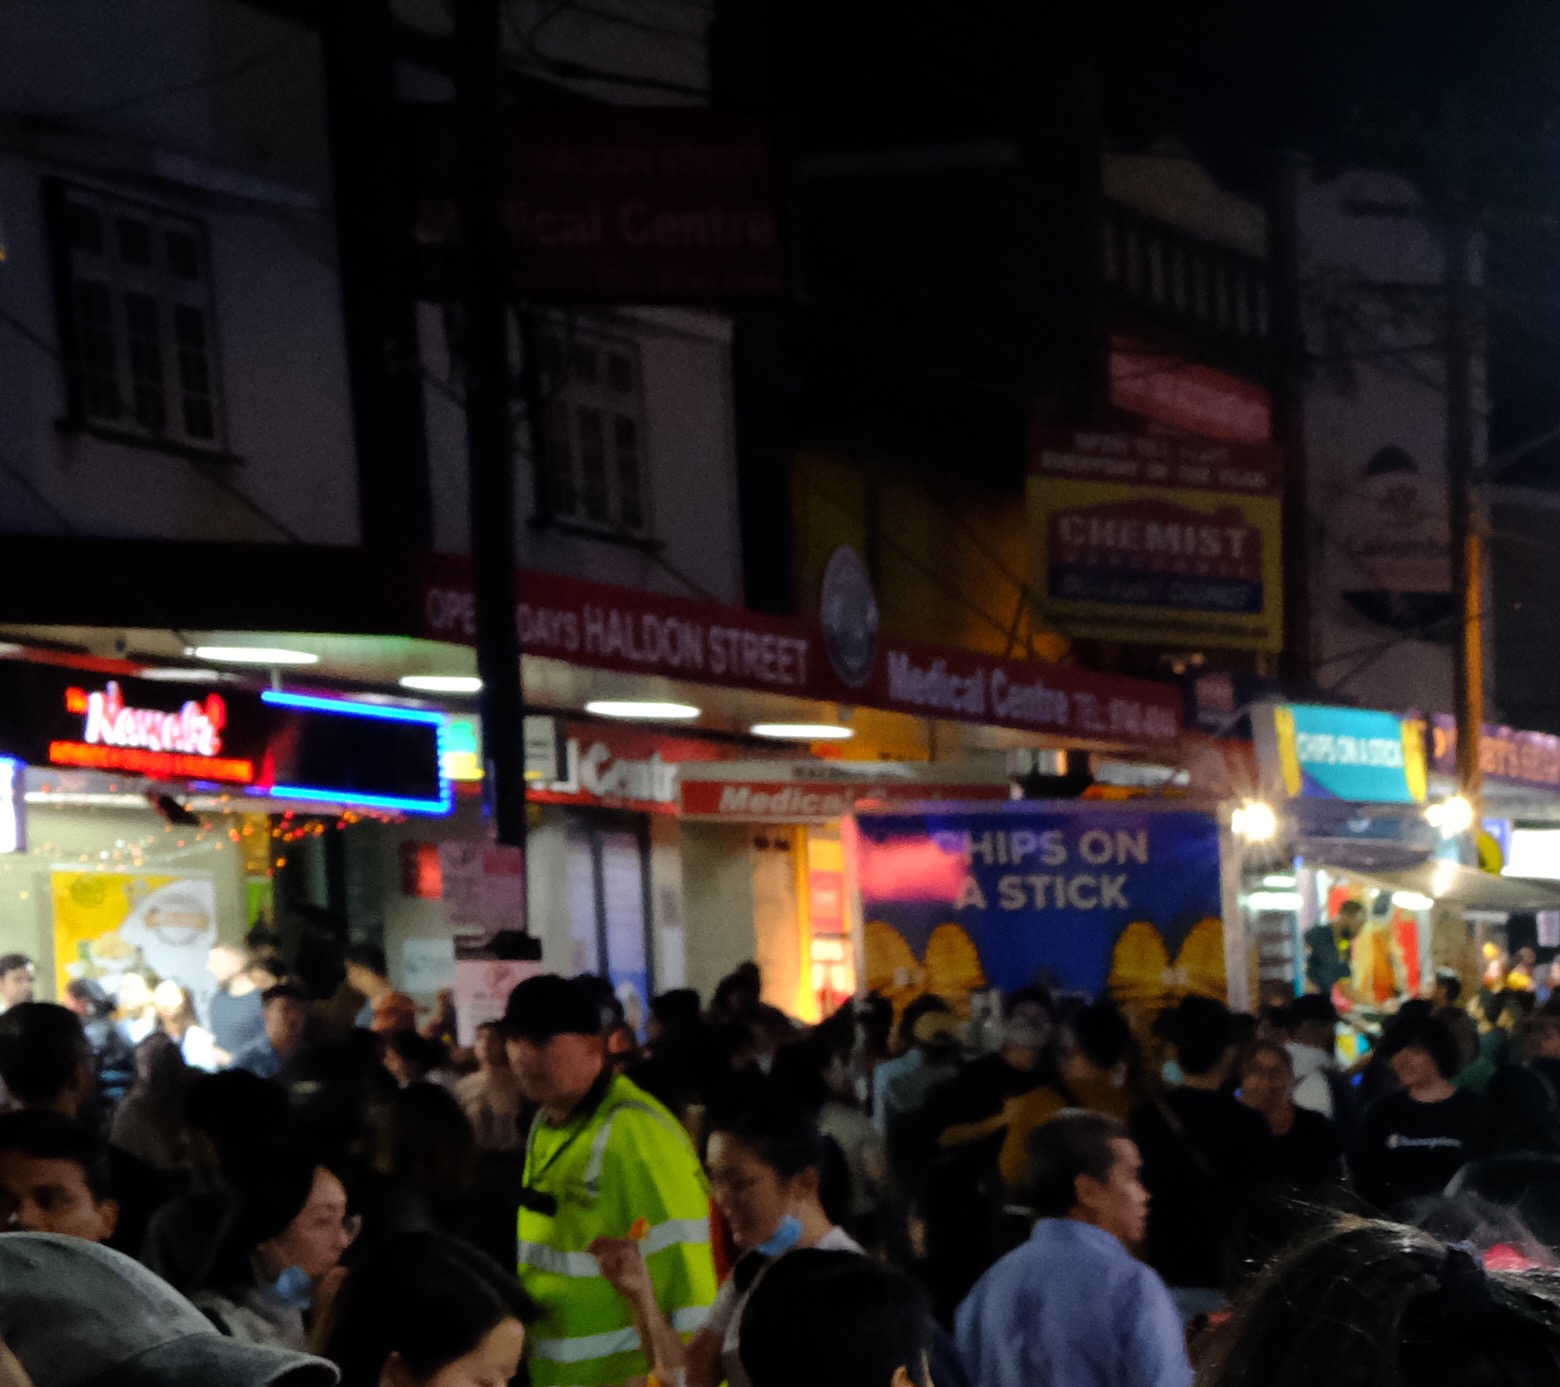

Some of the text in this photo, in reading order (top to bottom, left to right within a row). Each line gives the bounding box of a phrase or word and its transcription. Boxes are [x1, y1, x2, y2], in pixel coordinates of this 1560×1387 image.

[1057, 515, 1248, 560] CHEMIST
[425, 588, 476, 634] OPE
[583, 604, 704, 669] HALDON
[708, 626, 808, 686] STREET
[887, 650, 984, 713] Medical
[991, 667, 1069, 726] Centre
[719, 788, 854, 815] Medical
[1078, 830, 1149, 865] ON
[953, 873, 1130, 910] A STICK
